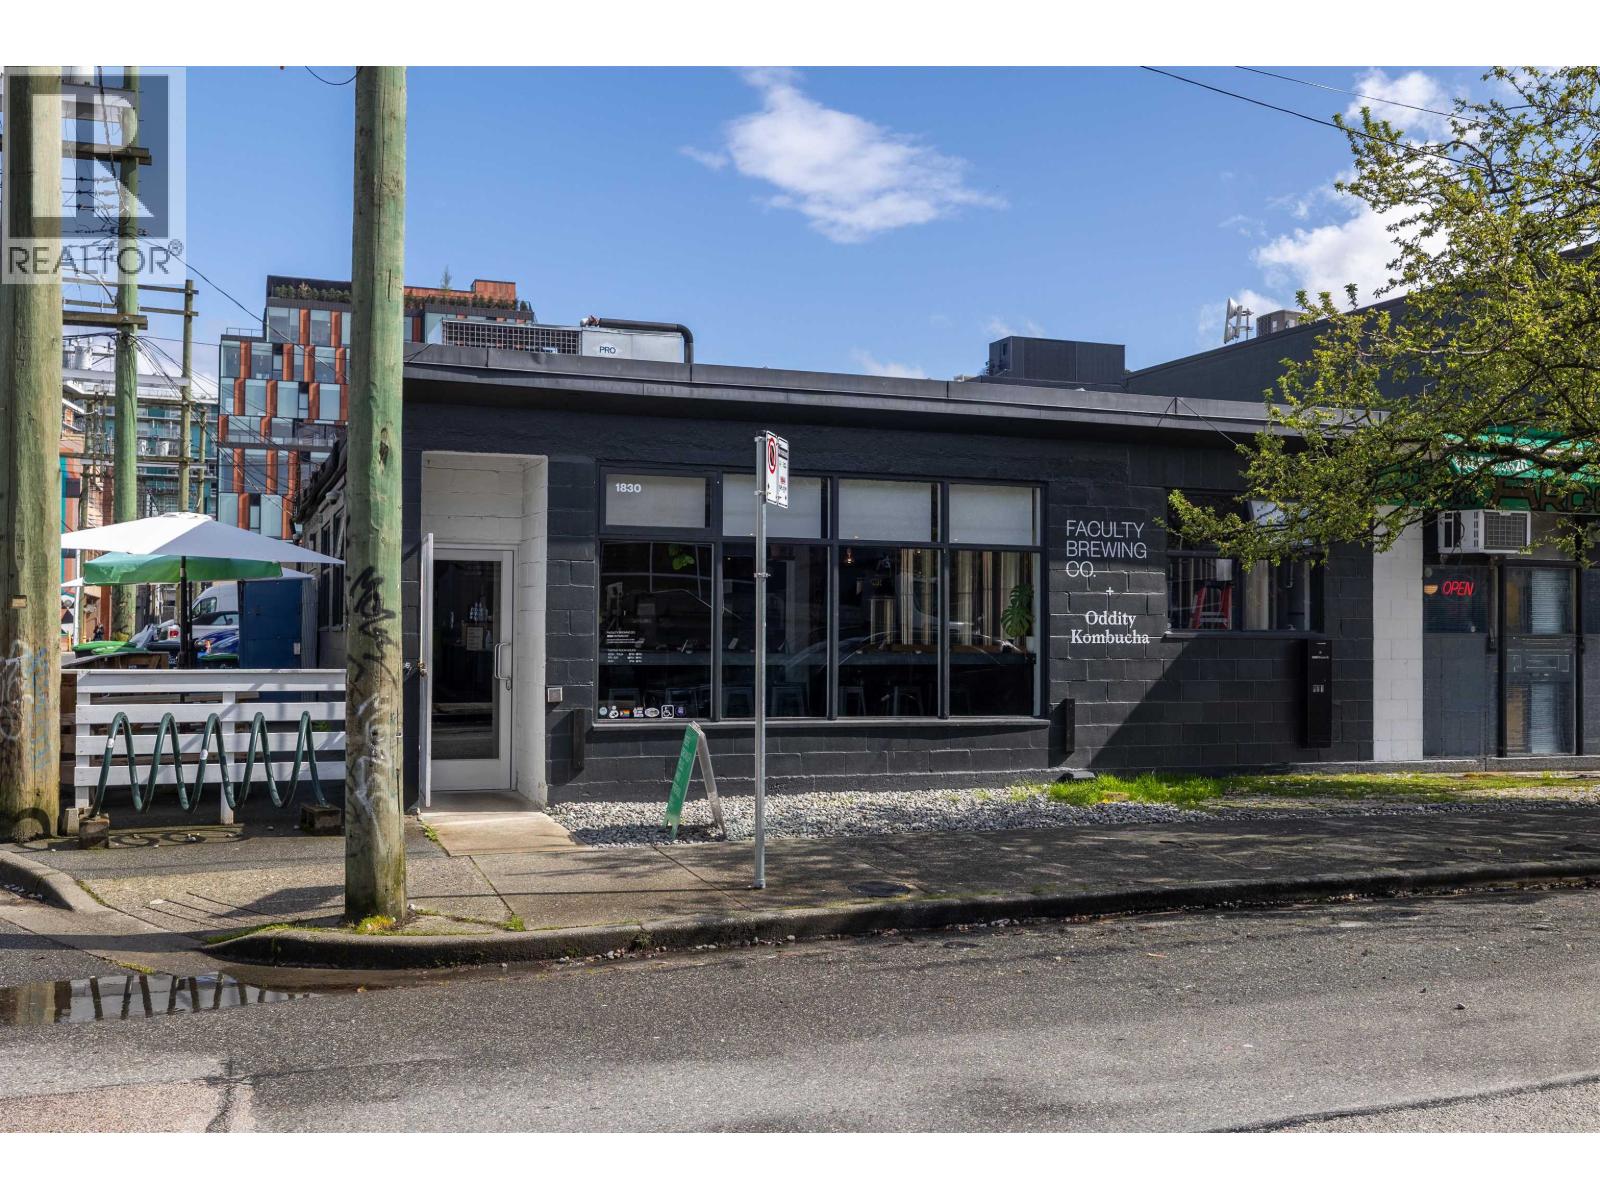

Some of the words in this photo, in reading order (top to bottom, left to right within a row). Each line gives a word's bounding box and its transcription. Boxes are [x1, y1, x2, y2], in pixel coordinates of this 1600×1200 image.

[599, 346, 616, 354] PRO
[616, 483, 641, 493] 1830
[1066, 520, 1144, 538] FACULTY
[1066, 541, 1147, 559] BREWING
[1066, 561, 1097, 578] CO.
[1442, 580, 1475, 597] OPEN
[1085, 610, 1136, 628] Oddity
[1071, 629, 1150, 644] Kombucha
